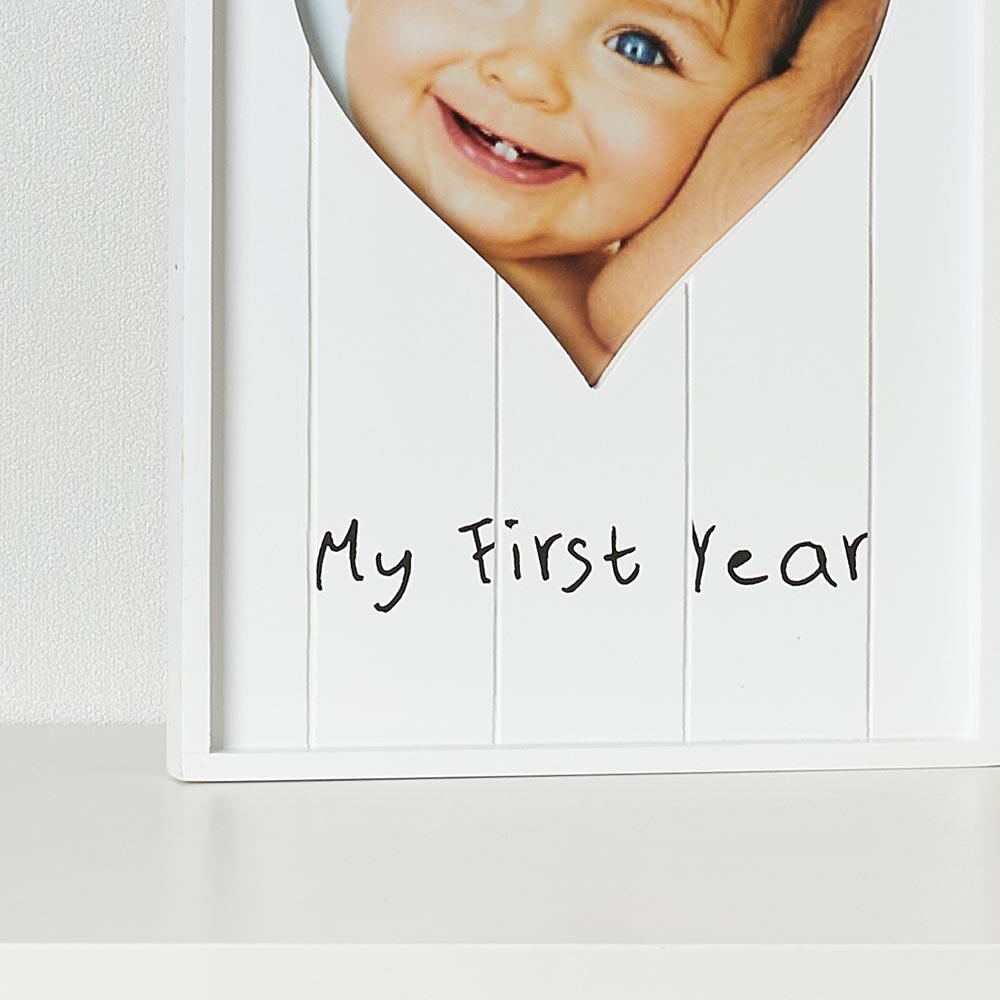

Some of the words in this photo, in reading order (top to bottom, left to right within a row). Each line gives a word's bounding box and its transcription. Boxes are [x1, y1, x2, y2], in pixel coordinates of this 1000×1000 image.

[315, 518, 413, 614] My
[457, 517, 641, 594] First
[690, 518, 869, 594] Year
